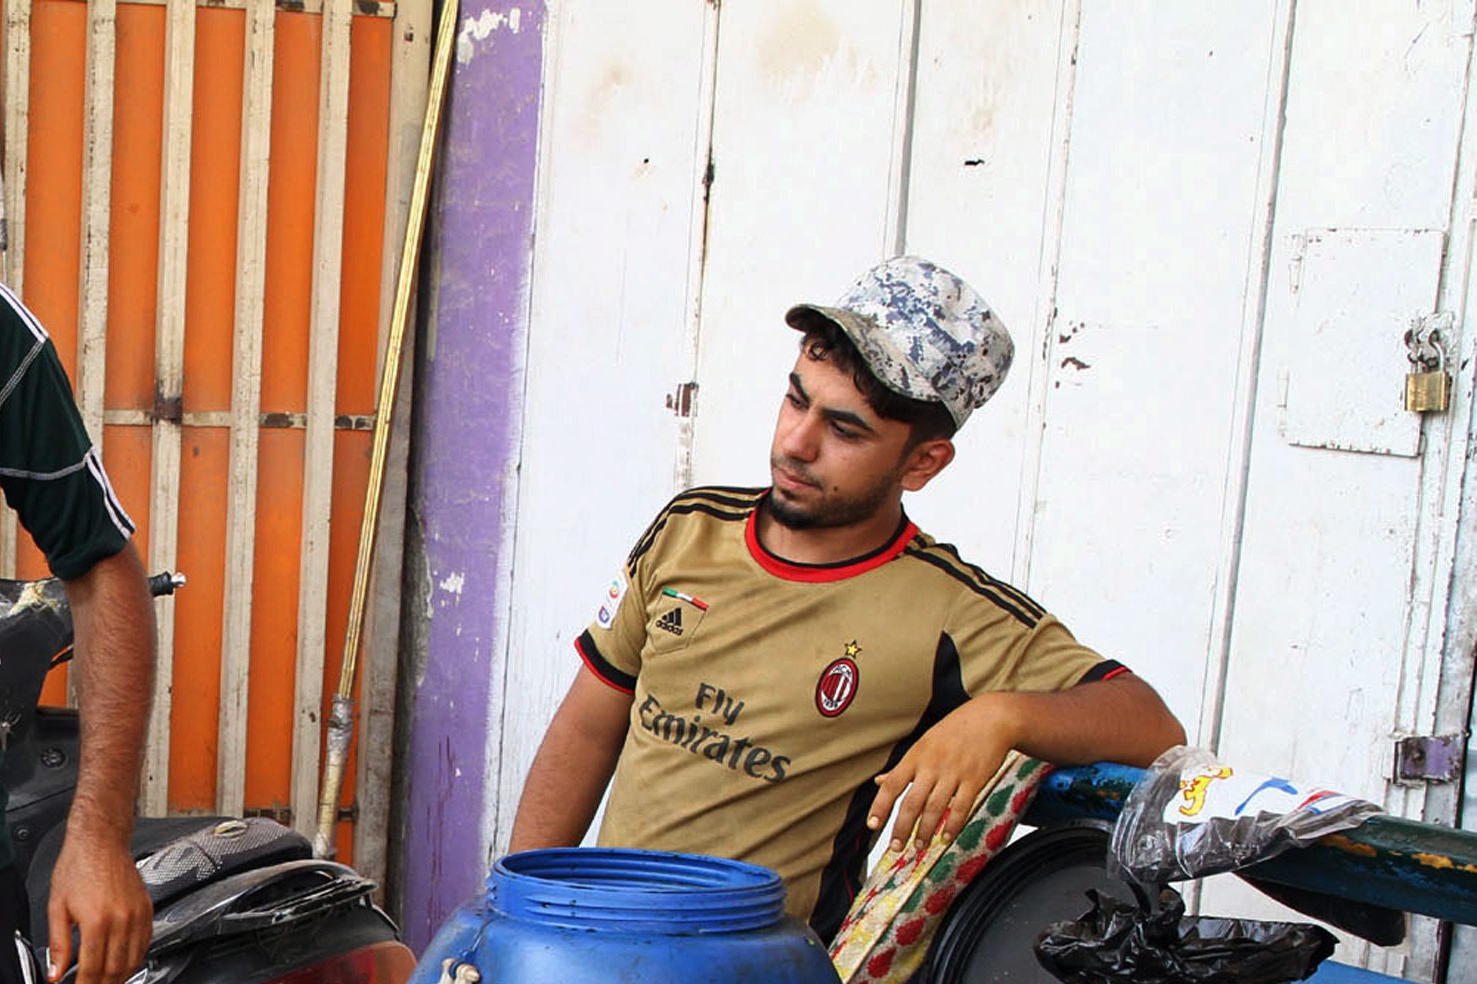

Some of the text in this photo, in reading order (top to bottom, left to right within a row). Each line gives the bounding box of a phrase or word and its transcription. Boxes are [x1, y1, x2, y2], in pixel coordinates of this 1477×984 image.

[655, 619, 684, 636] adidas
[694, 682, 745, 726] Fly
[638, 693, 792, 784] Emirates
